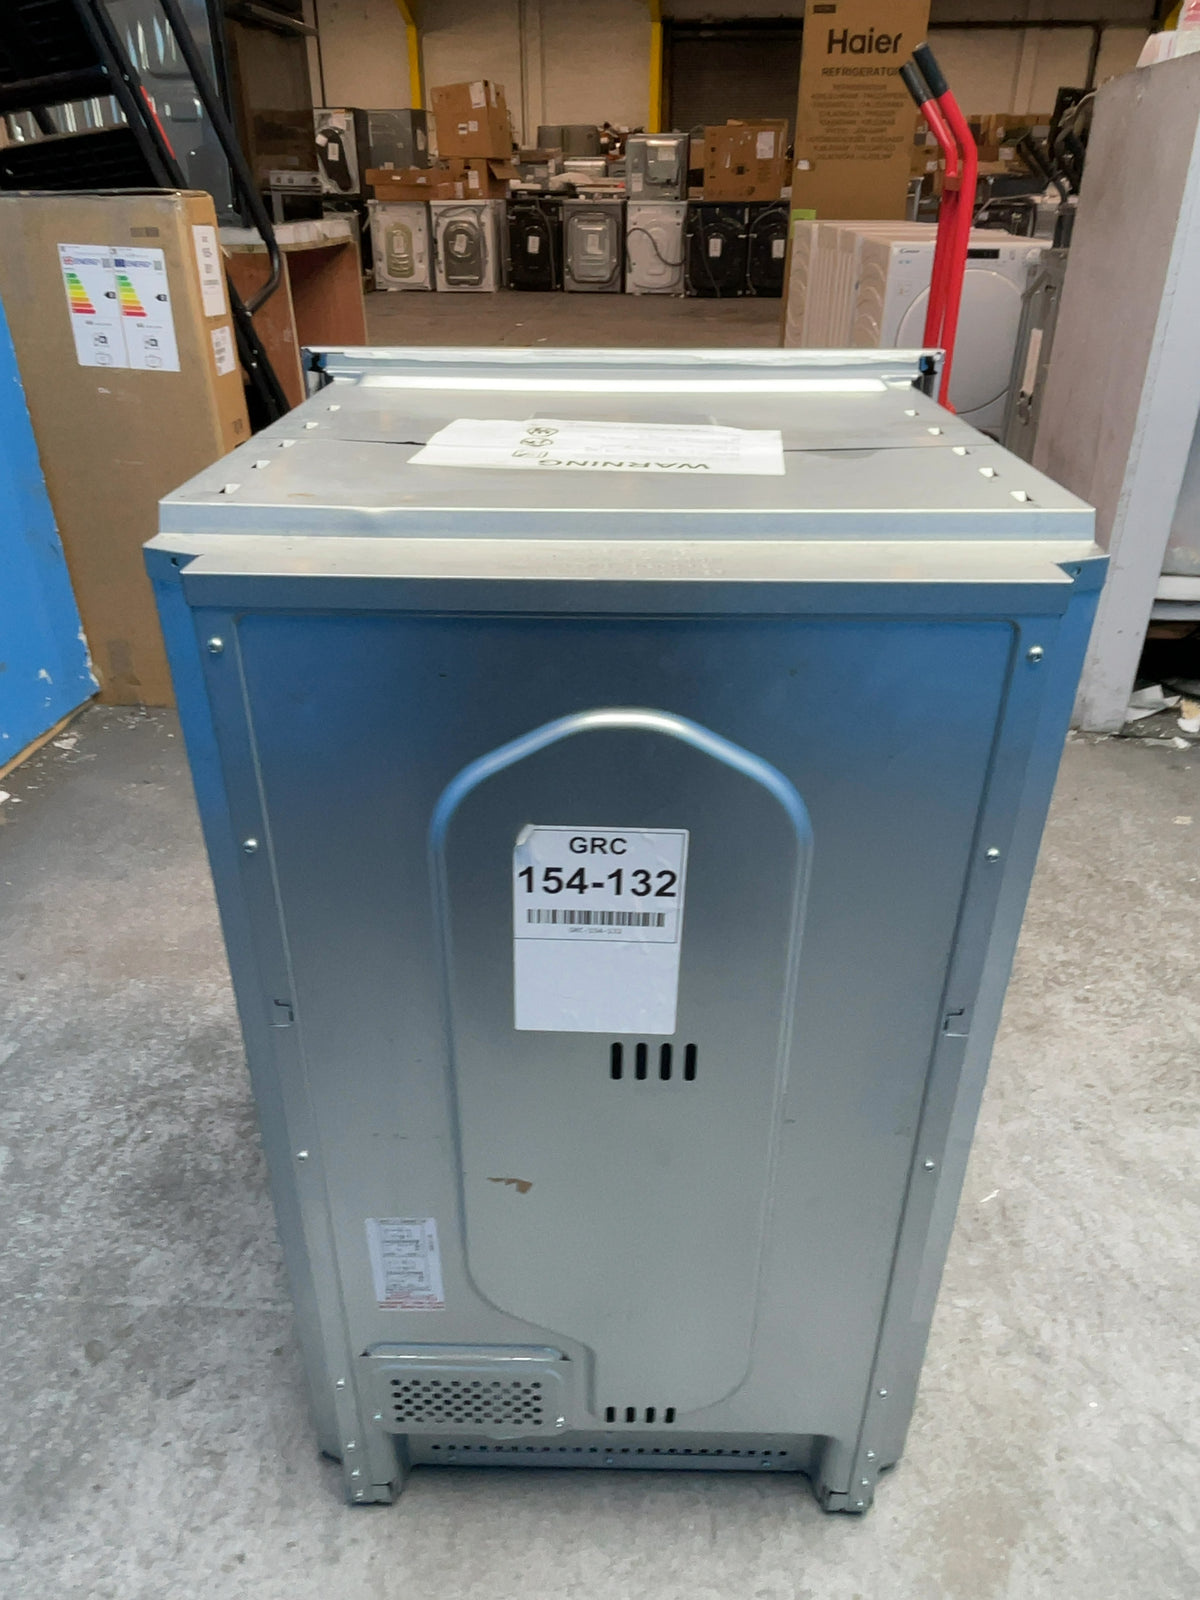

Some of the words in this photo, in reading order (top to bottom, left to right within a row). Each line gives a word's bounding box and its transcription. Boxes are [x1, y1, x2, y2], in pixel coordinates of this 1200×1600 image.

[827, 28, 902, 54] Haier
[538, 460, 710, 470] WARNING
[569, 836, 627, 854] GRC
[518, 866, 677, 897] 154-132
